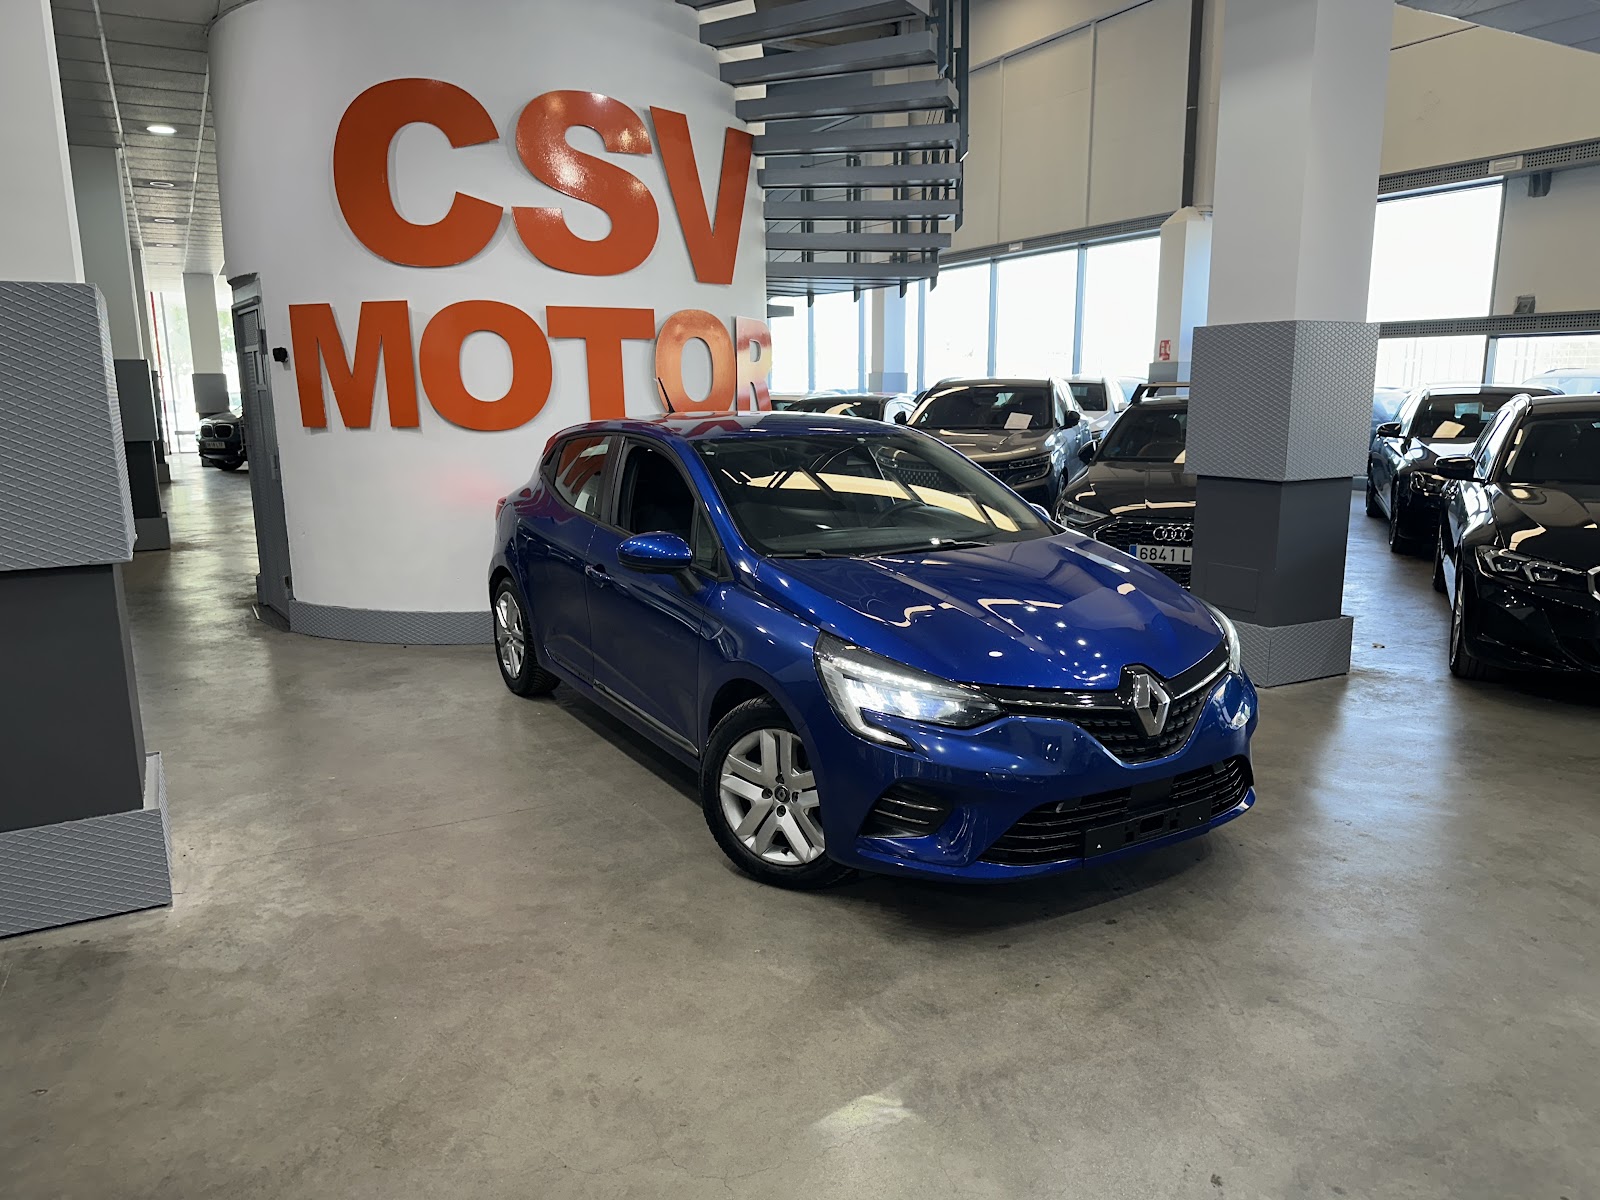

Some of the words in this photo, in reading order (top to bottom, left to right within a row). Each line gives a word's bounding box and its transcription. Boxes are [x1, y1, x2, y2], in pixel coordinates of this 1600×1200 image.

[333, 77, 755, 285] CSV
[289, 299, 773, 431] MOTOR
[1140, 547, 1175, 561] 6841
